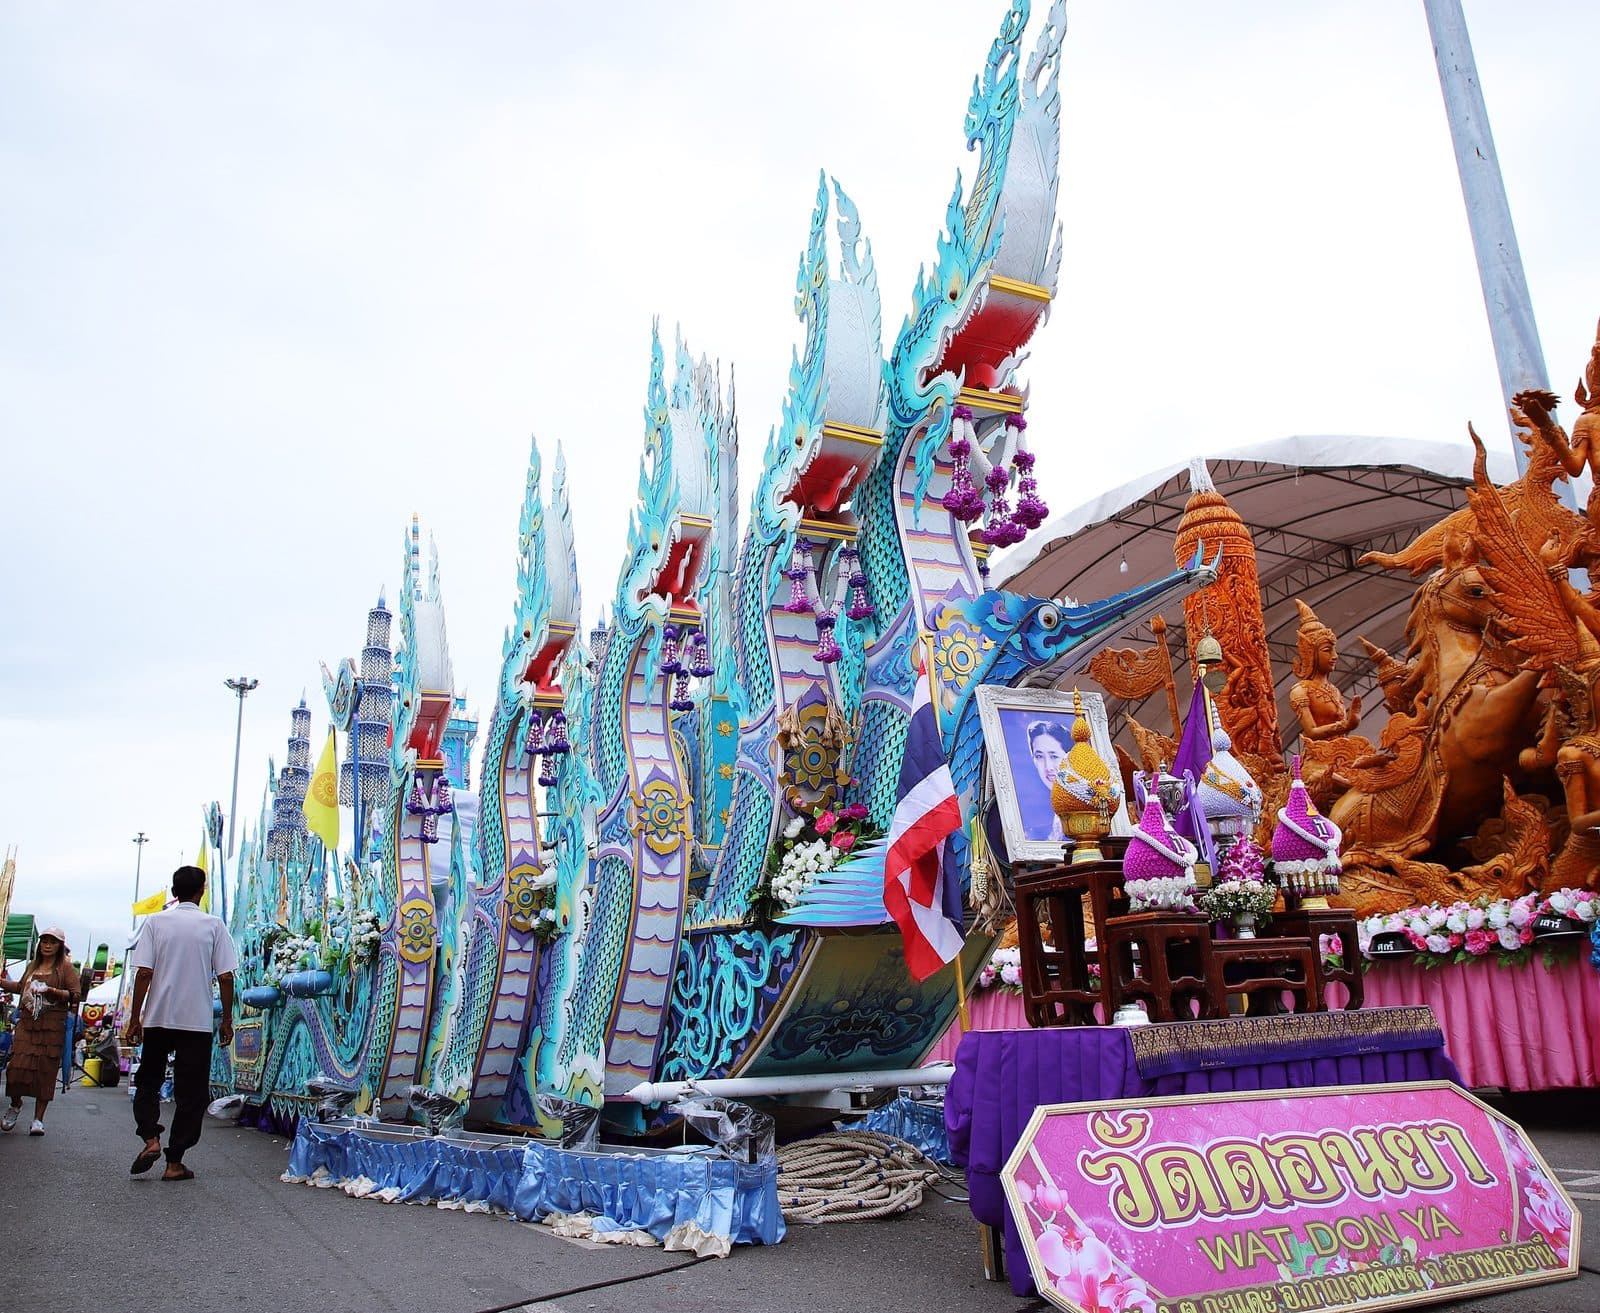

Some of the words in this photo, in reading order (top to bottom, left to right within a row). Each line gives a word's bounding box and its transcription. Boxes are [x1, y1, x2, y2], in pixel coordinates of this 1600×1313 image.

[1081, 1110, 1494, 1229] วัดดอนยา
[1197, 1227, 1293, 1273] WAT
[1303, 1213, 1402, 1258] DON
[1399, 1205, 1463, 1241] YA
[1424, 1230, 1559, 1285] จ.สราษฎร์ธานี
